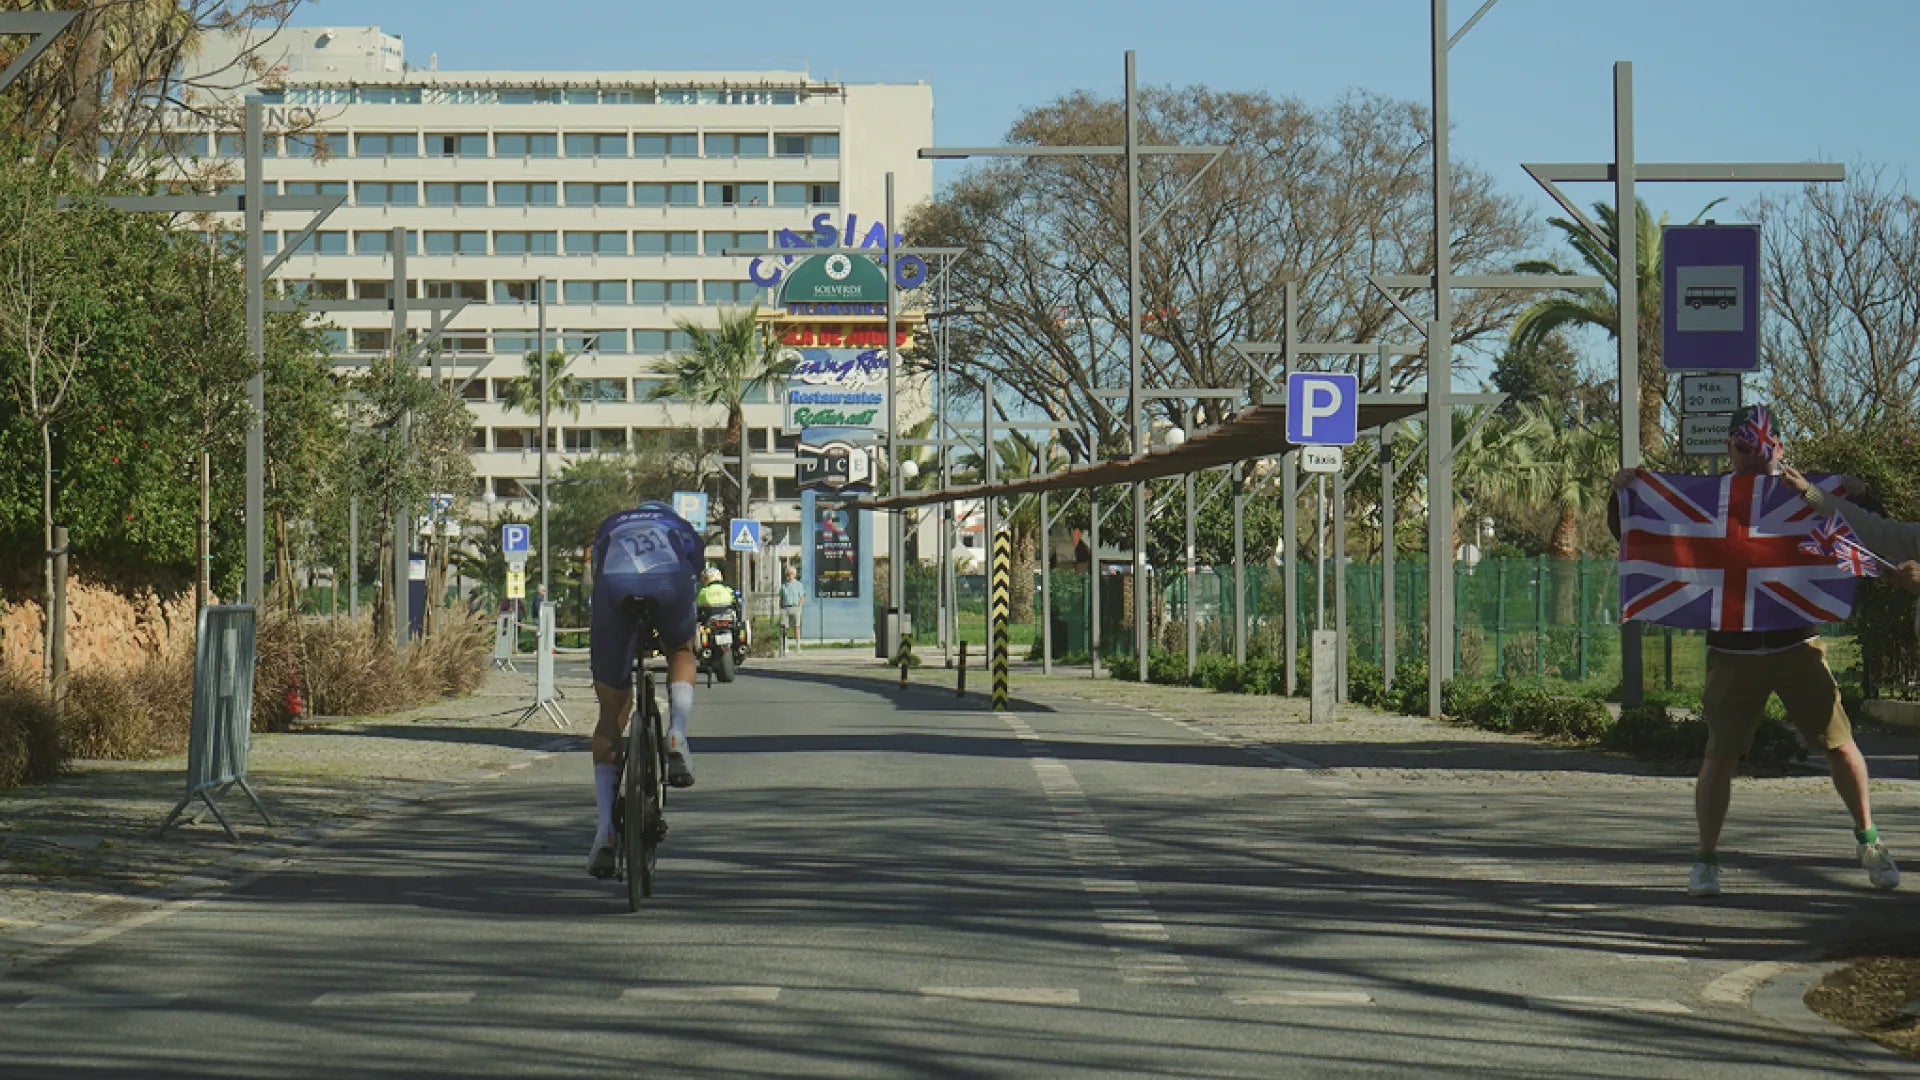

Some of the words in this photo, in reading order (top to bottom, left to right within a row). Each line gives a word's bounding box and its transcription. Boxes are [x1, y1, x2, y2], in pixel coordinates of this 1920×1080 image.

[748, 212, 929, 290] CASINO
[1302, 379, 1343, 437] P
[1691, 424, 1729, 435] Serviço
[680, 495, 700, 520] P
[507, 527, 524, 550] P
